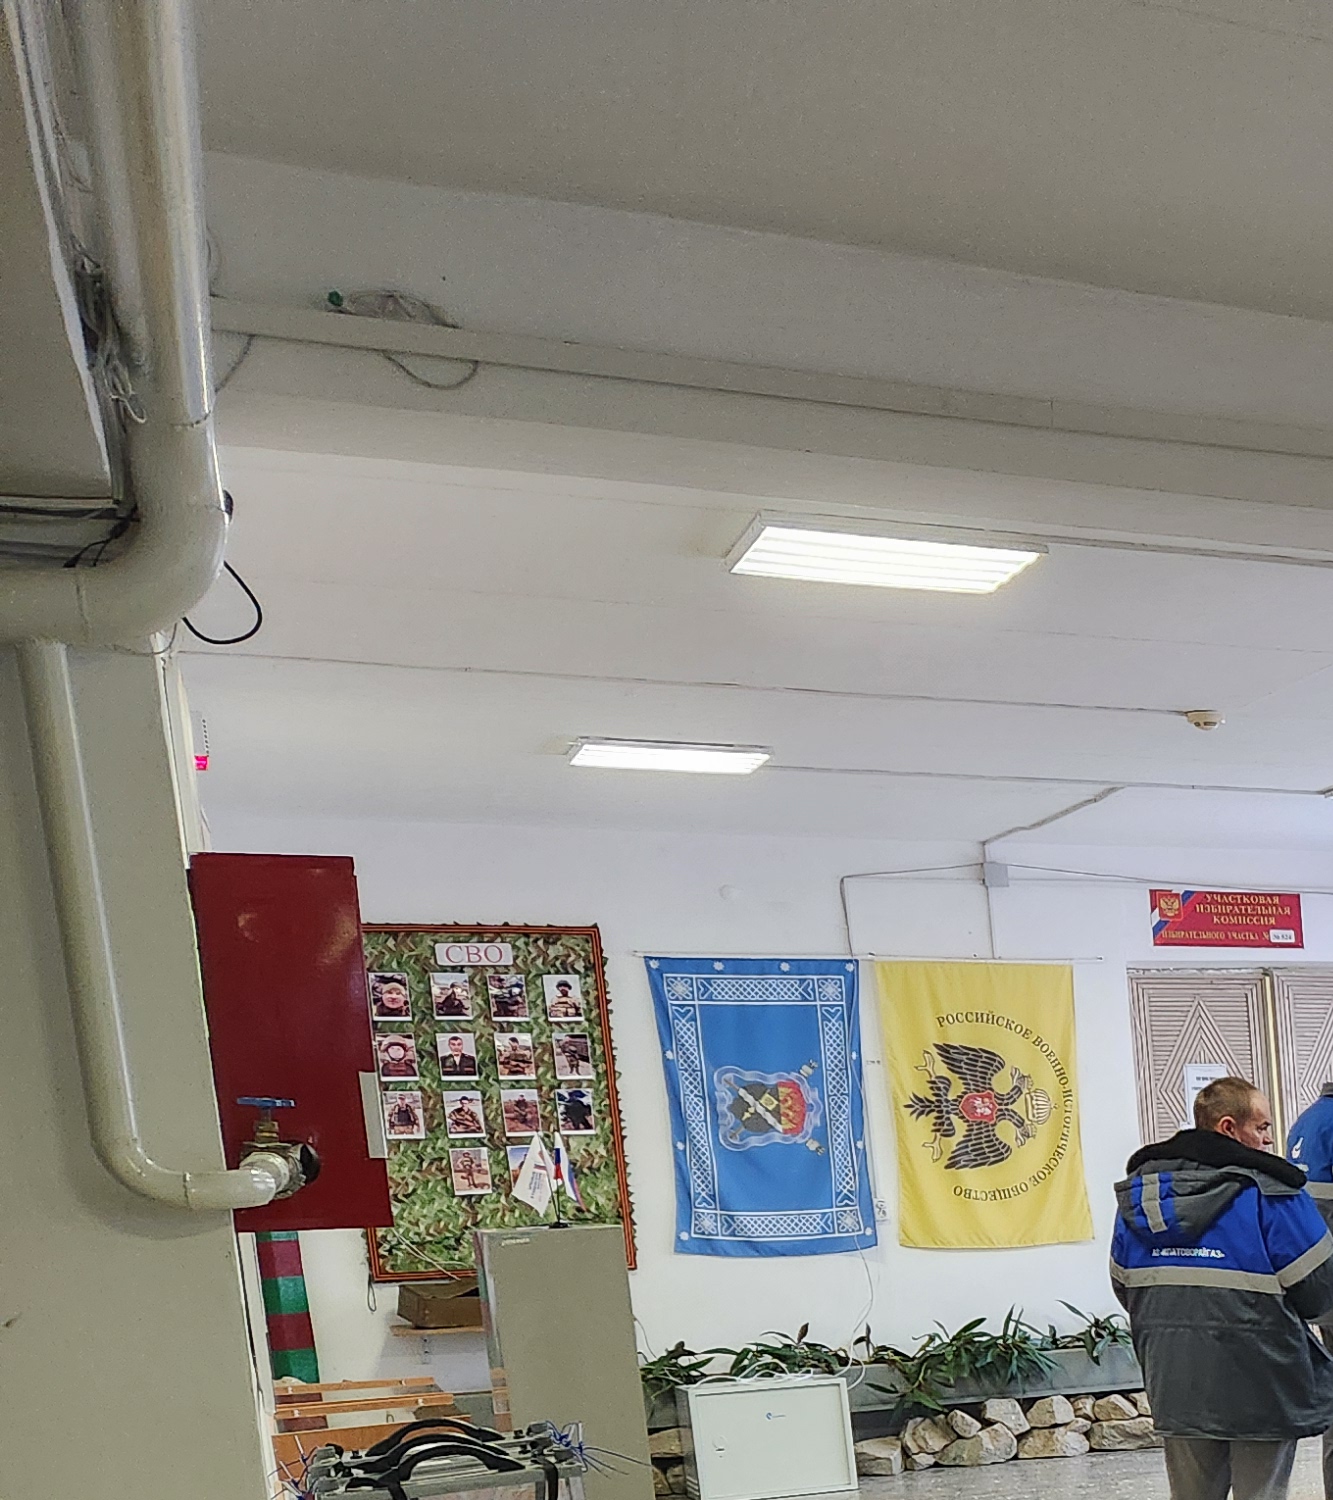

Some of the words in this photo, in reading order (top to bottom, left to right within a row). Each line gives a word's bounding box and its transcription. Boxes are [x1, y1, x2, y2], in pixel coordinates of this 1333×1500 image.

[1204, 893, 1280, 905] УЧАСТКОВАЯ
[1195, 904, 1291, 916] ИЗБИРАТЕЛЬНАЯ
[1213, 915, 1276, 926] КОМИССИЯ
[445, 945, 503, 964] СВО
[936, 1010, 1033, 1040] РОССИЙСКОЕ
[953, 1182, 1030, 1202] ОБЩЕСТВО
